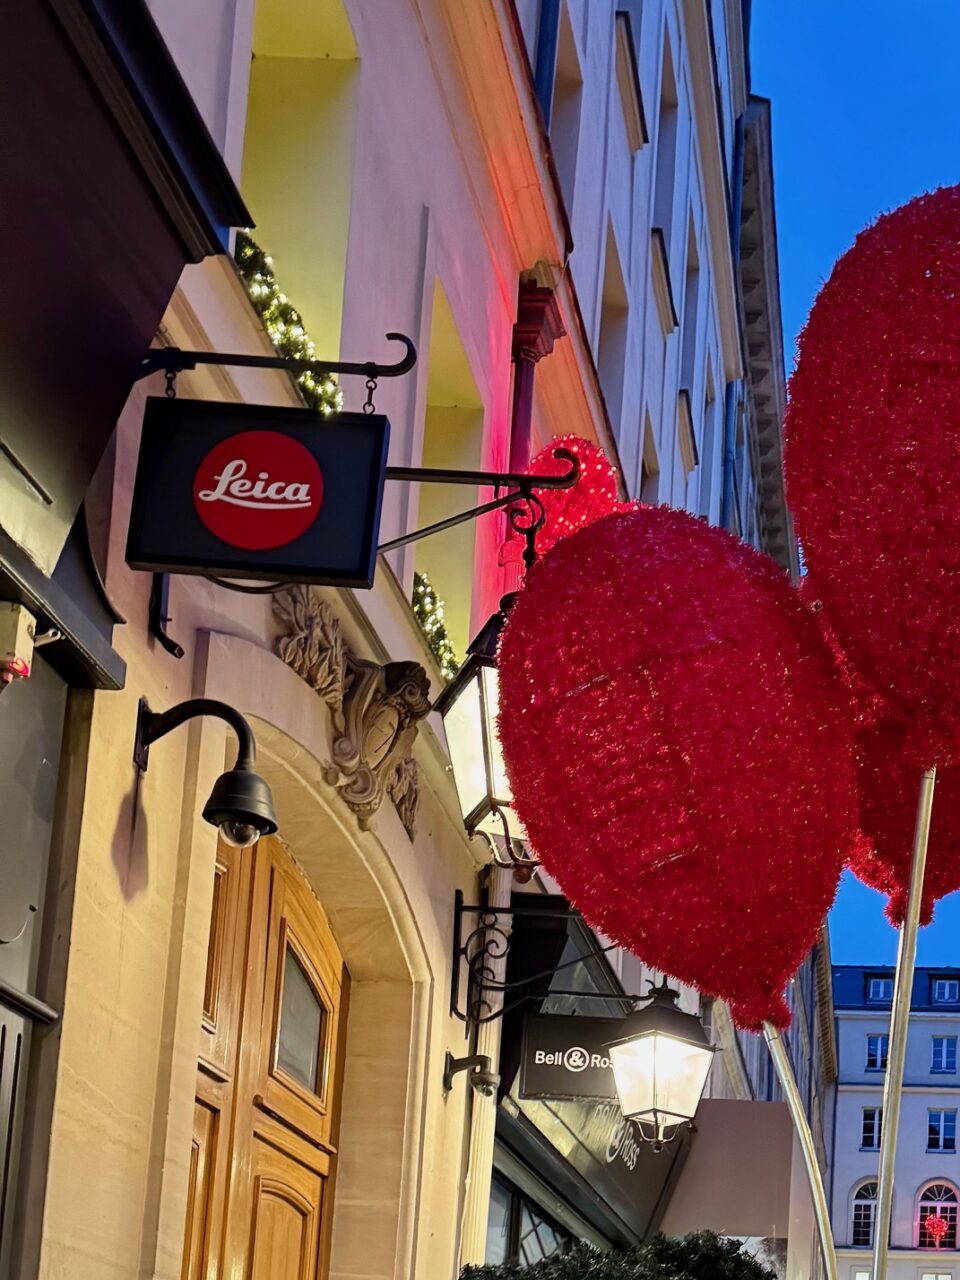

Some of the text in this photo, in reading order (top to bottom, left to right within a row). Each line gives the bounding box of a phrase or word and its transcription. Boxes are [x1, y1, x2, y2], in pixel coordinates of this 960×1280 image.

[198, 459, 311, 509] Leica
[535, 1050, 563, 1066] Bell
[591, 1054, 614, 1068] Ro
